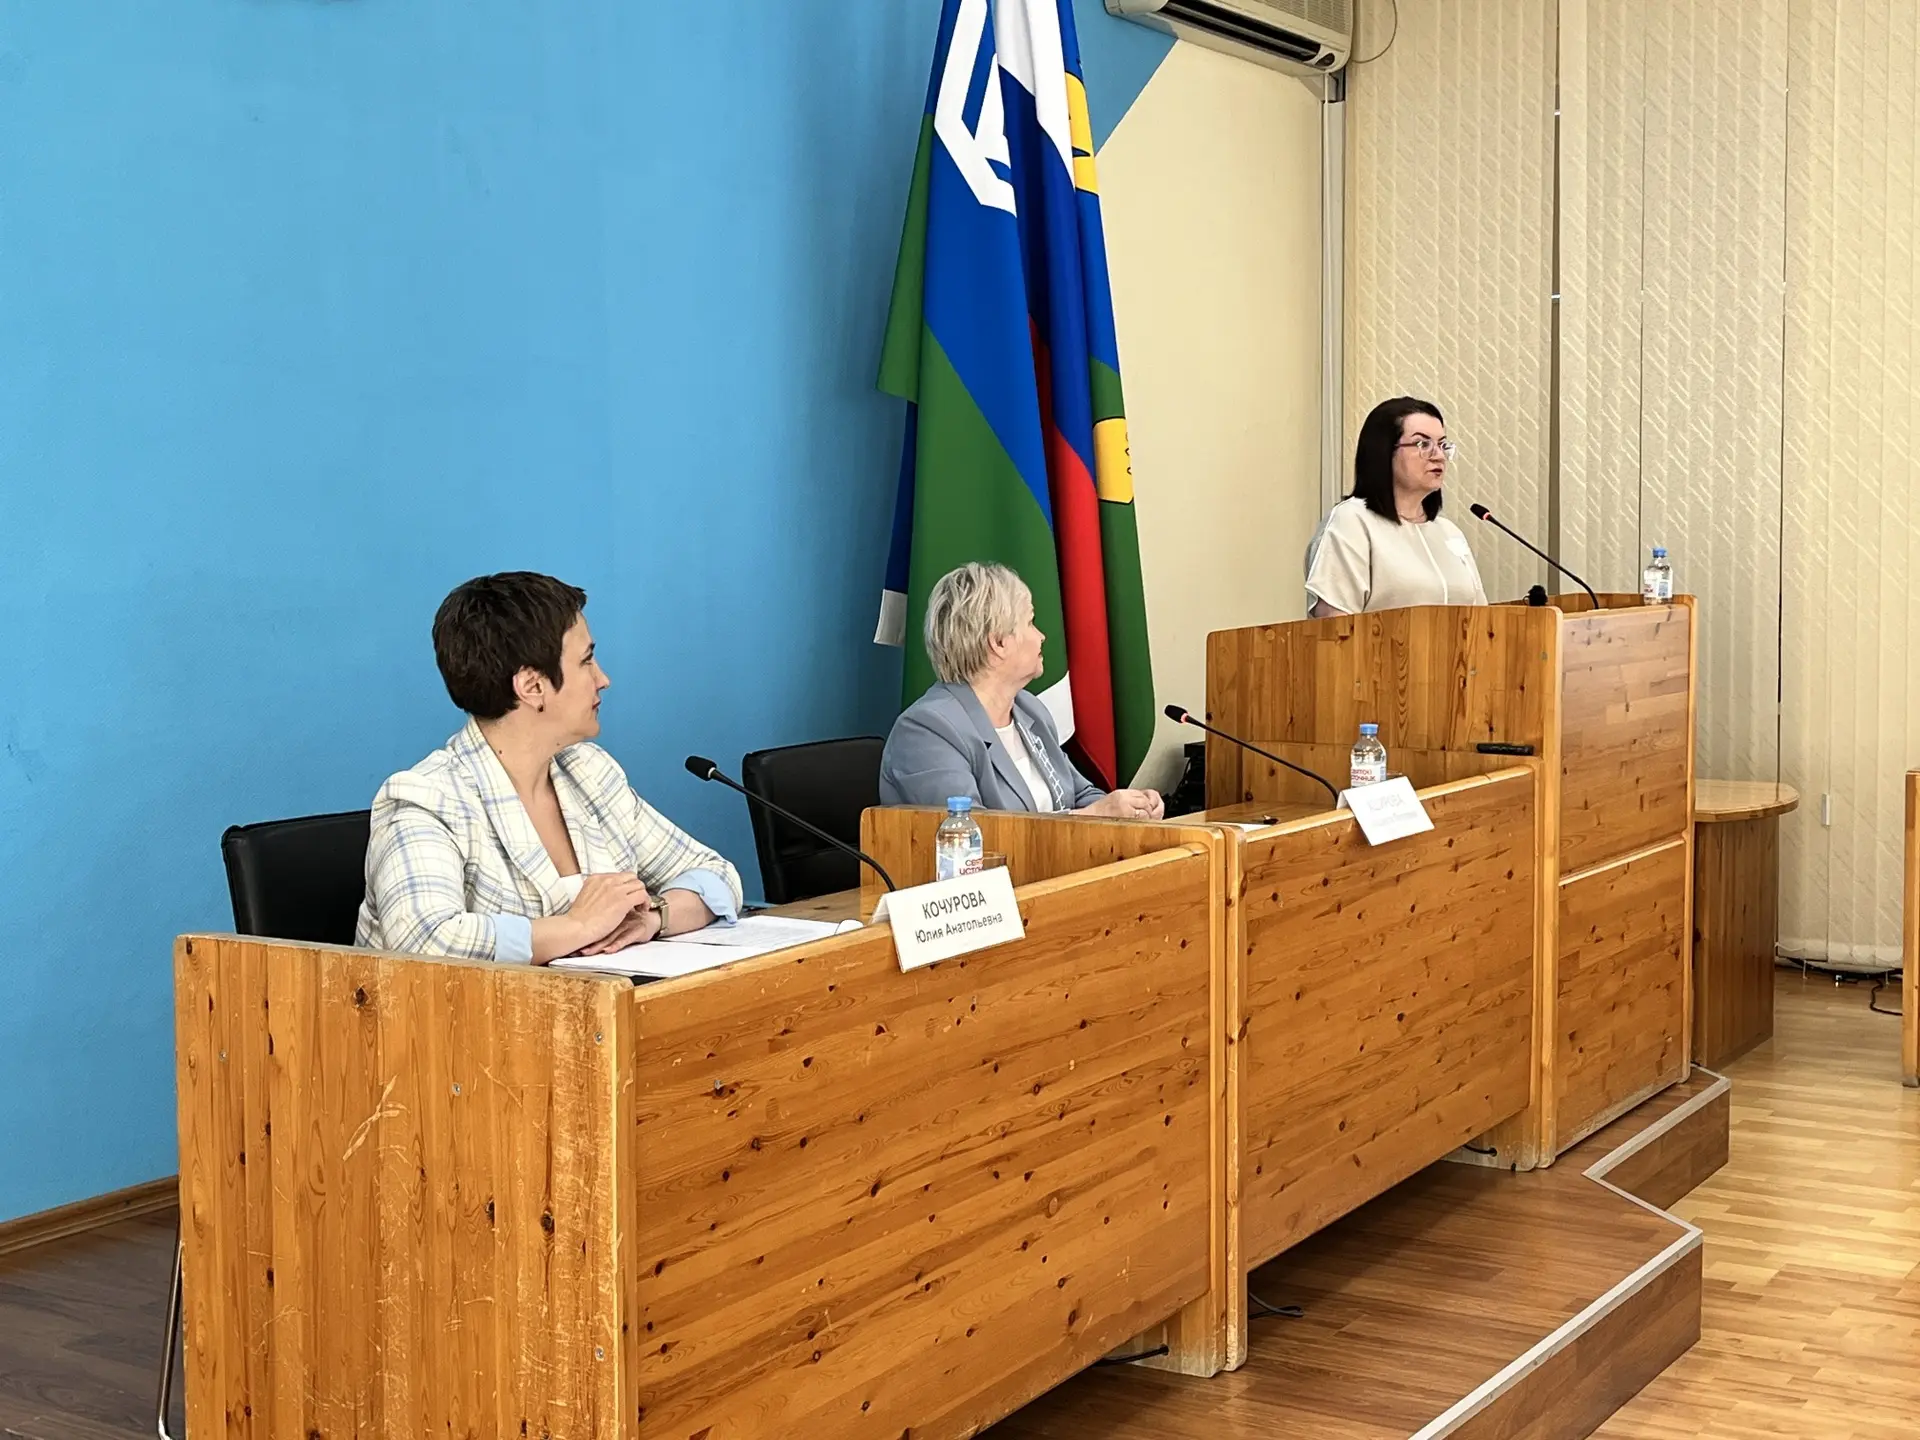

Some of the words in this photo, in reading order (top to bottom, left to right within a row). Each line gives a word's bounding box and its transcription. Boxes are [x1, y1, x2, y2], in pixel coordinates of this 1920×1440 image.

[922, 890, 986, 919] КОЧУРОВА
[915, 929, 944, 943] Юлия
[946, 913, 1003, 936] Анатольевна
